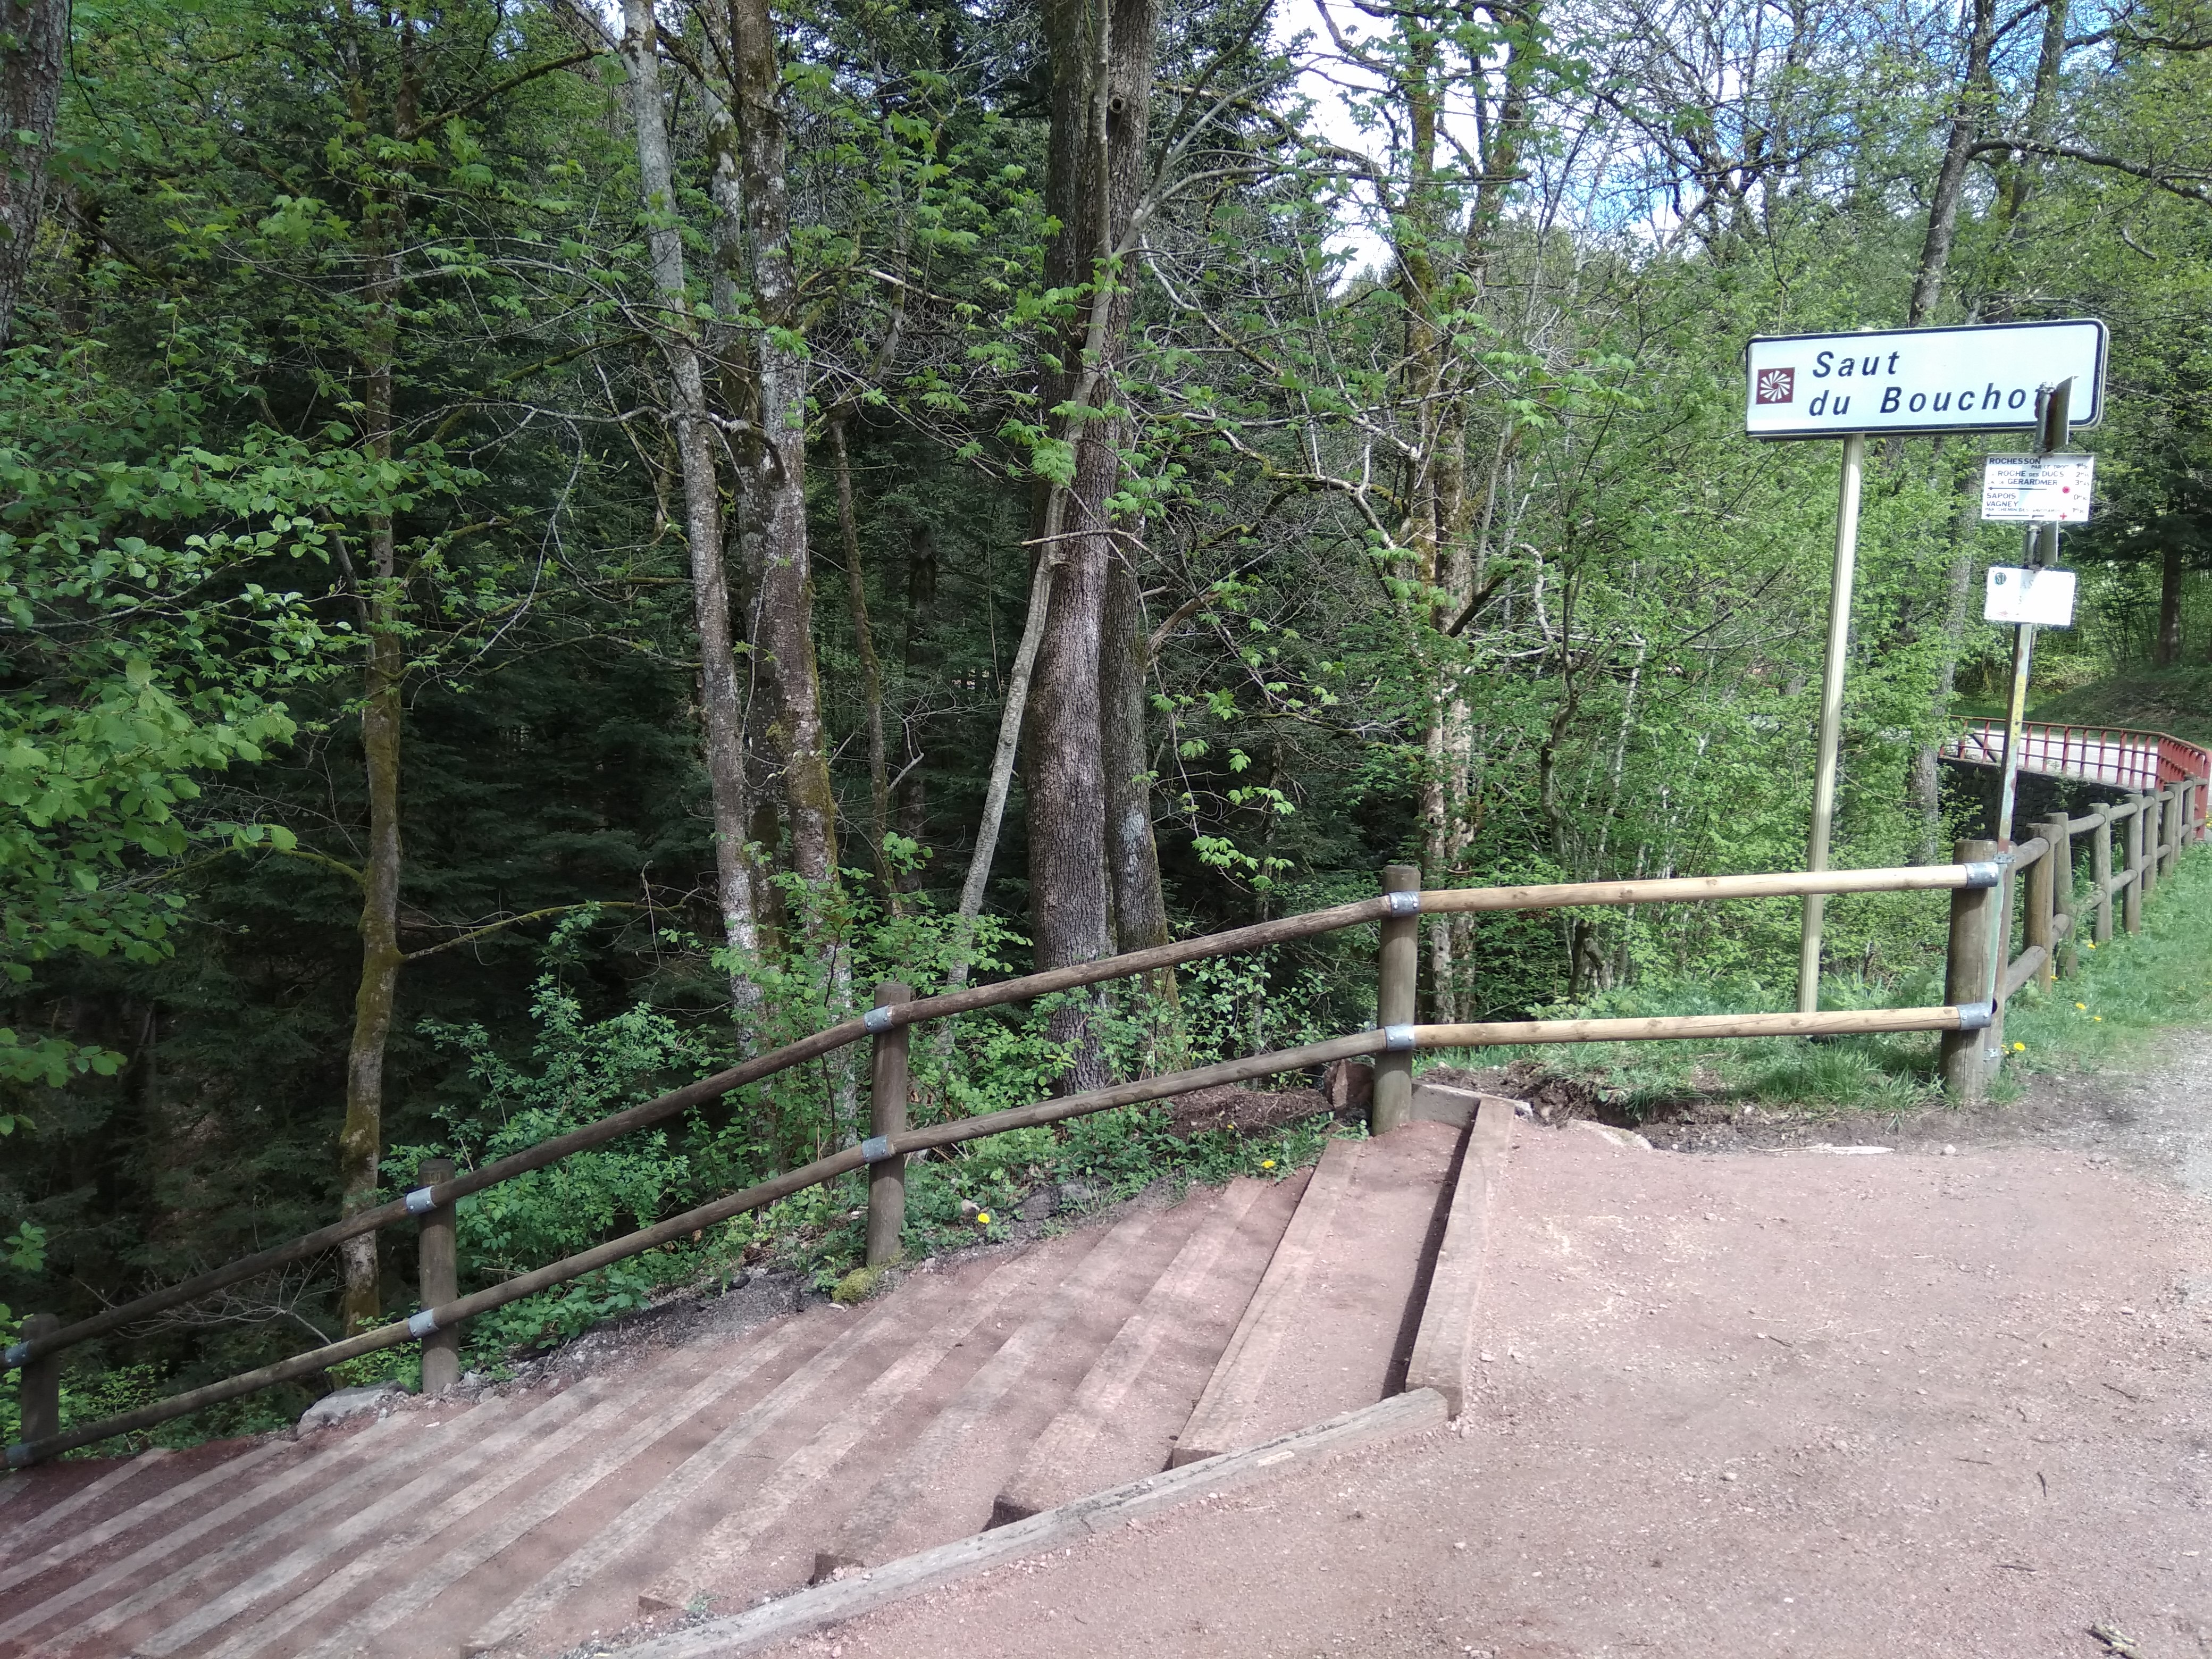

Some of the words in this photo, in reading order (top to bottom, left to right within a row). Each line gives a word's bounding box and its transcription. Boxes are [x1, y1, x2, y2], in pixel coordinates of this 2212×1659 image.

[1813, 350, 1900, 378] Saut
[1808, 389, 1850, 416] du
[1880, 382, 2040, 414] Boucho
